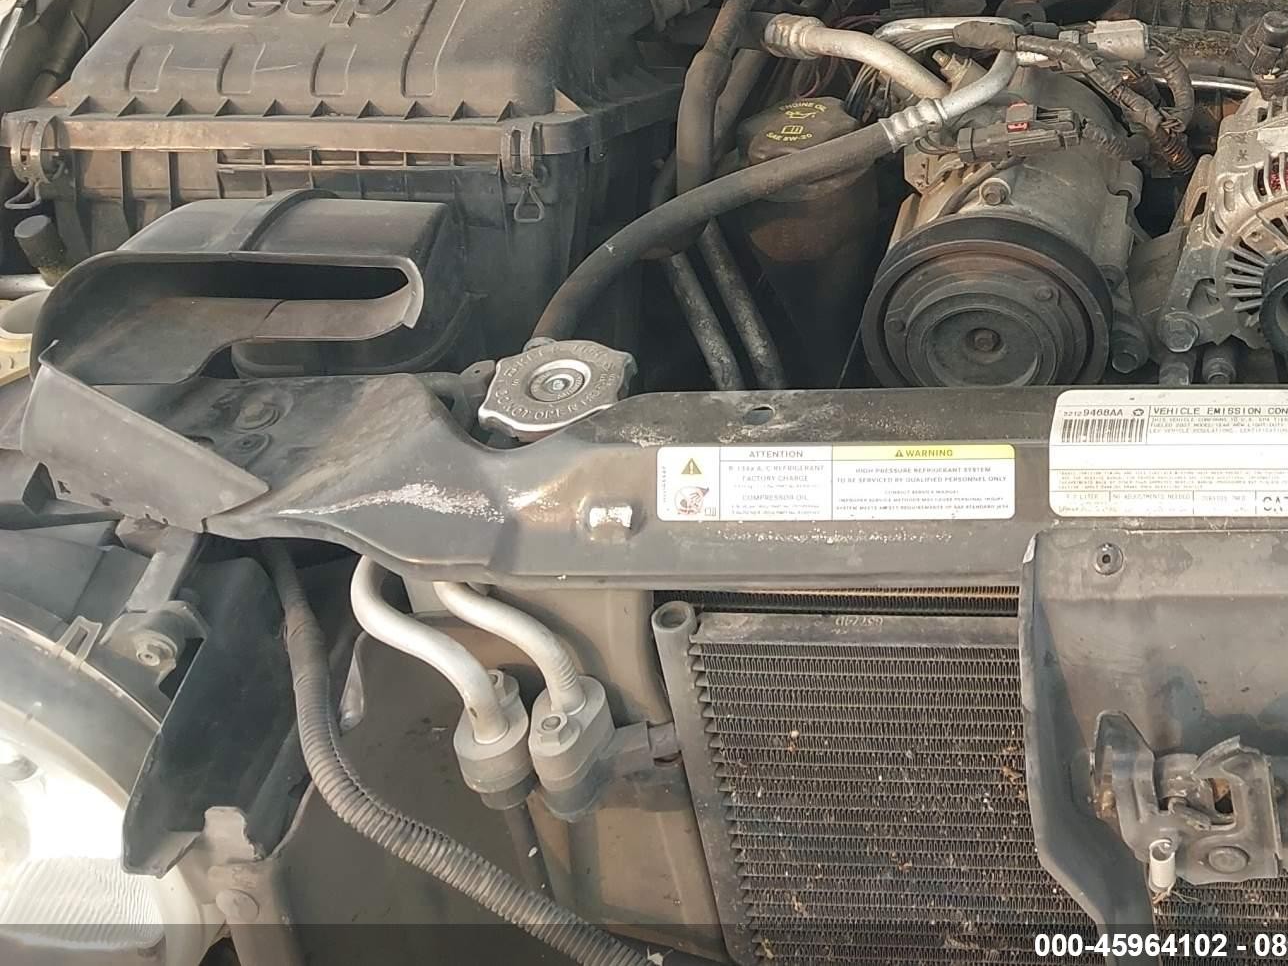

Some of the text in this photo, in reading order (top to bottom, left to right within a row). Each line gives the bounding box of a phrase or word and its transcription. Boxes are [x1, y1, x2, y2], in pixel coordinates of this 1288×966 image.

[778, 102, 815, 110] ENGINE
[1154, 407, 1200, 415] VEHICLE
[1207, 407, 1261, 415] EMISSION
[748, 450, 804, 458] ATTENTION
[905, 449, 953, 458] WARNING
